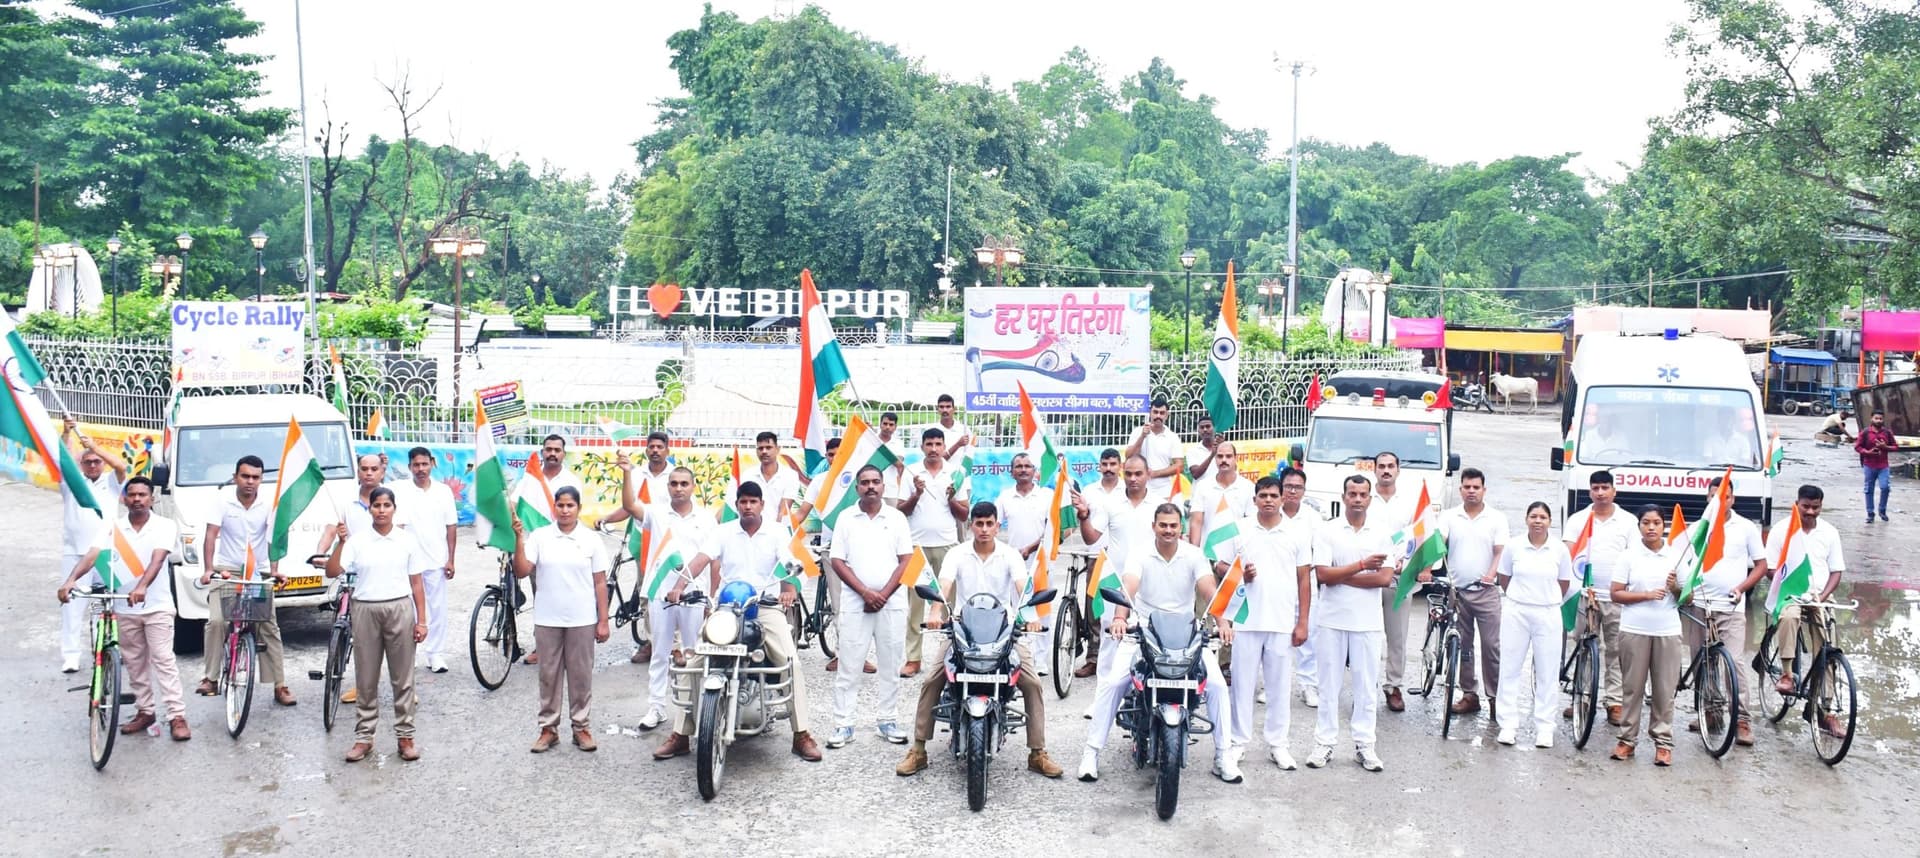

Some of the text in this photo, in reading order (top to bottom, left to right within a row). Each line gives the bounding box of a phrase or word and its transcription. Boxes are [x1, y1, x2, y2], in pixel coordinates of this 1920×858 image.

[610, 286, 617, 313] I
[995, 291, 1125, 335] हर घर तिरंगा
[173, 305, 304, 331] Cycle Rally
